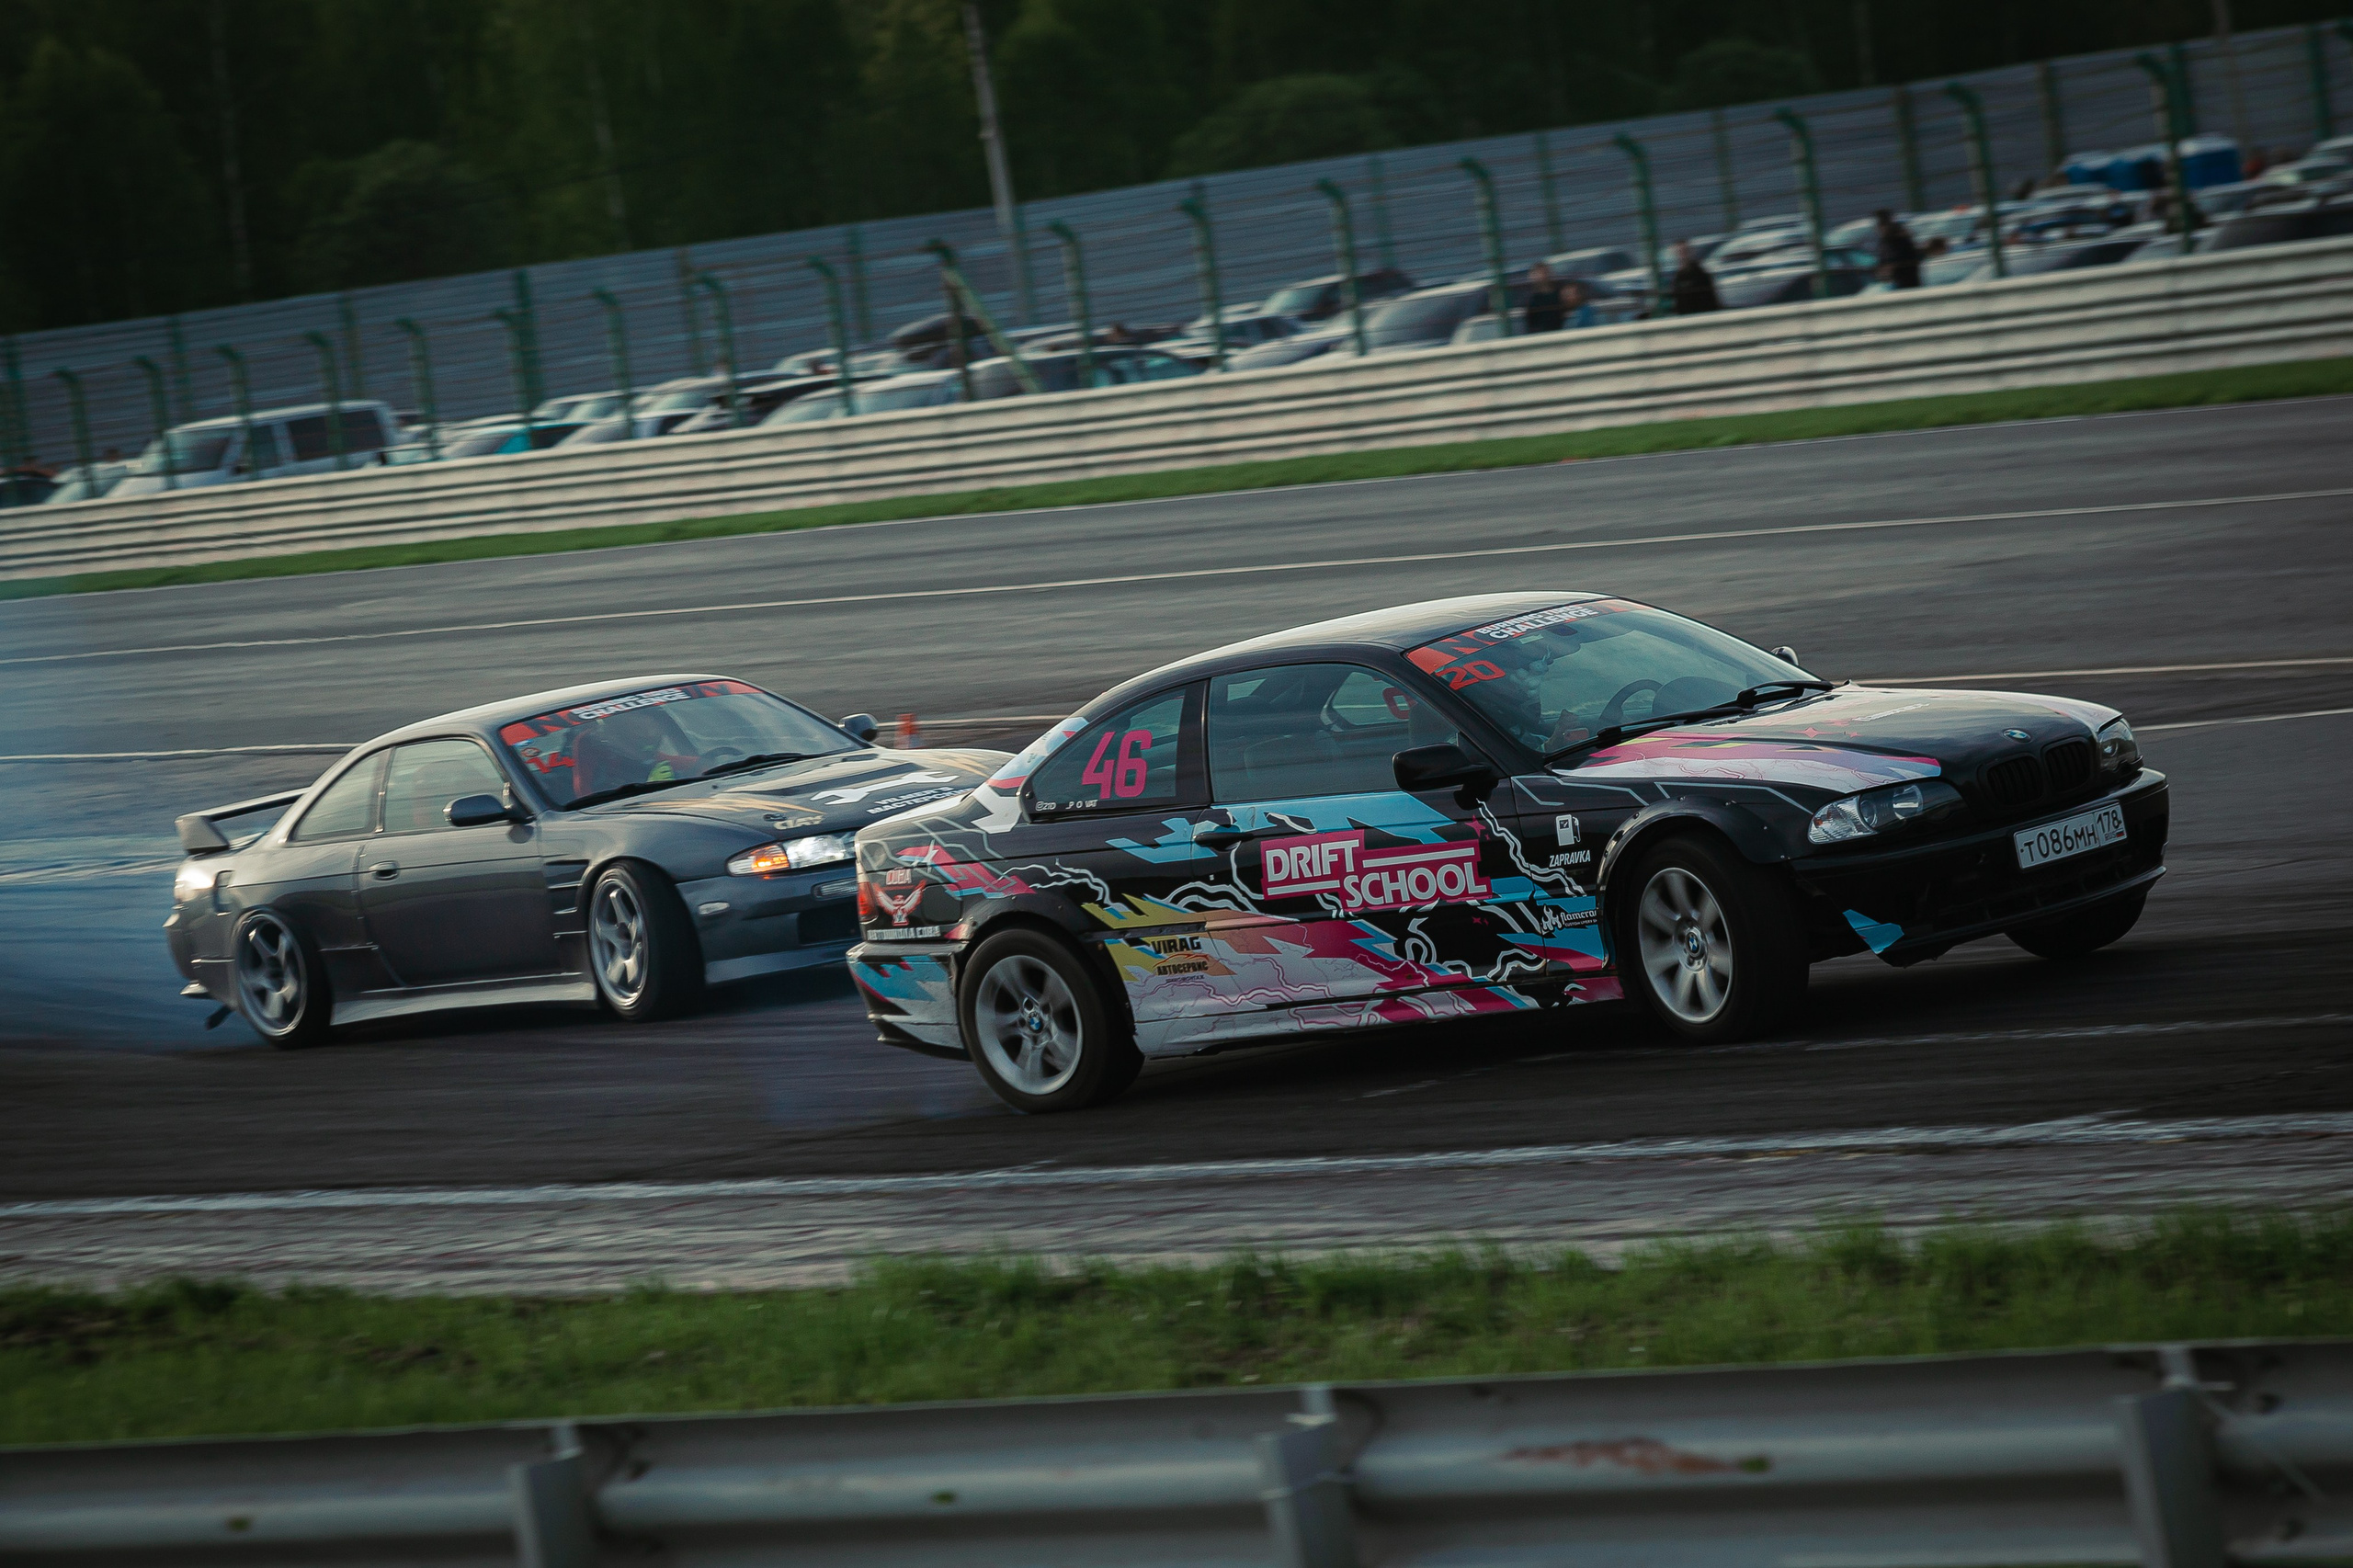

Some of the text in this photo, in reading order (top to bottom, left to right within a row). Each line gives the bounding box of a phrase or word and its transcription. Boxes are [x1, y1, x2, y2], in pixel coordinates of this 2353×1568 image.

[1474, 610, 1537, 634] BURNING
[1489, 607, 1598, 639] CHALLENGE
[1435, 660, 1506, 690] 20
[579, 689, 691, 720] CHALLENGE
[525, 751, 576, 773] 14
[1081, 729, 1153, 800] 46
[2097, 809, 2120, 834] 178
[1266, 839, 1359, 882] DRIFT
[1549, 849, 1591, 868] ZAPRAVKA
[1343, 862, 1487, 908] SCHOOL
[1151, 937, 1201, 954] VIRAG
[1156, 961, 1208, 975] АВТОСЕРВИС
